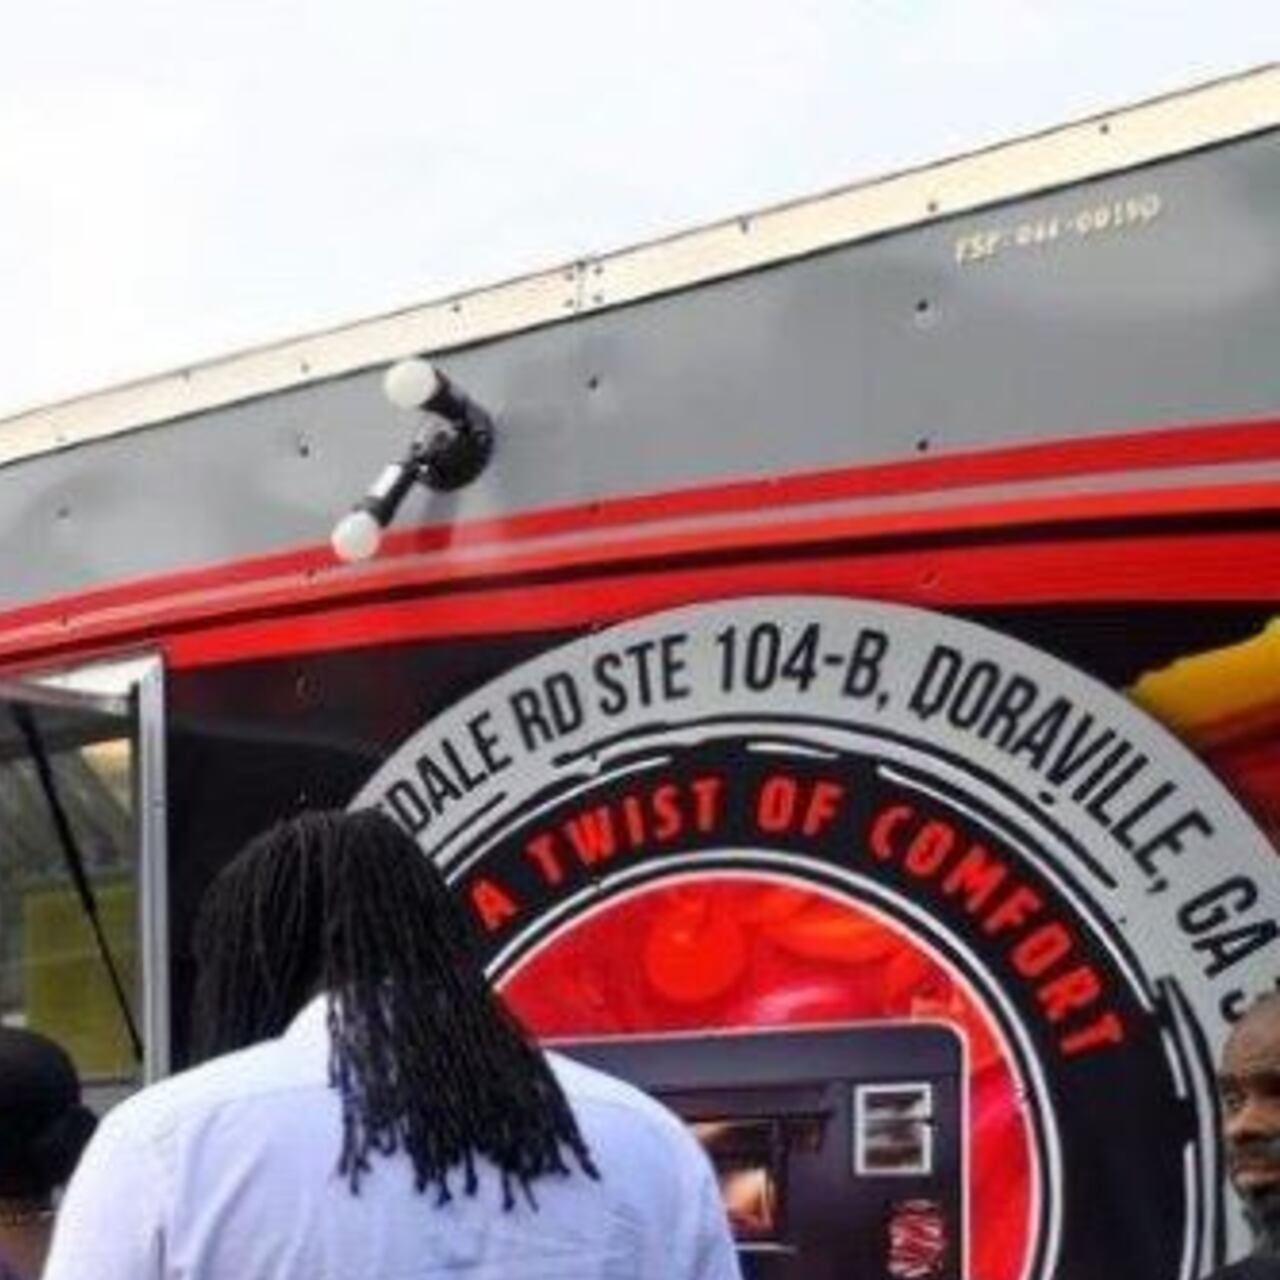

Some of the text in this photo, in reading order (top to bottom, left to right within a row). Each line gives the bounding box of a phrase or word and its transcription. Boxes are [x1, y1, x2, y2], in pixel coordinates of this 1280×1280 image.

[383, 622, 1278, 980] DALE RD STE 104-B, DORAVILLE, GA
[469, 878, 518, 932] A
[525, 778, 725, 886] TWIST
[757, 776, 844, 837] OF
[870, 805, 1125, 1055] COMFORT
